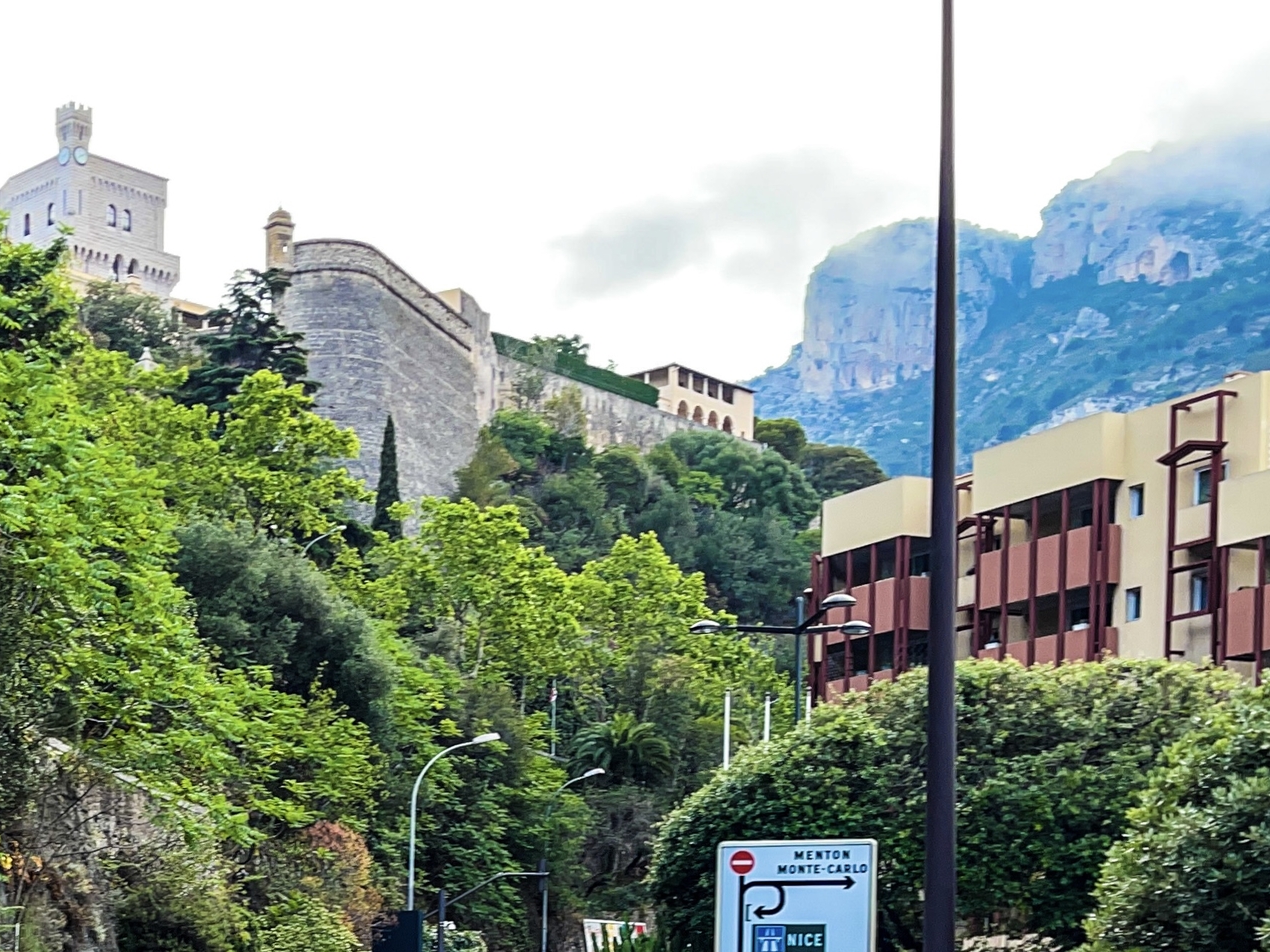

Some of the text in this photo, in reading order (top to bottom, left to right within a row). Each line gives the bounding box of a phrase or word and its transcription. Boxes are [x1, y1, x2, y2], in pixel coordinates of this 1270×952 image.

[794, 850, 850, 860] MENTON
[777, 864, 868, 874] MONTE-CARLO
[787, 933, 823, 946] NICE
